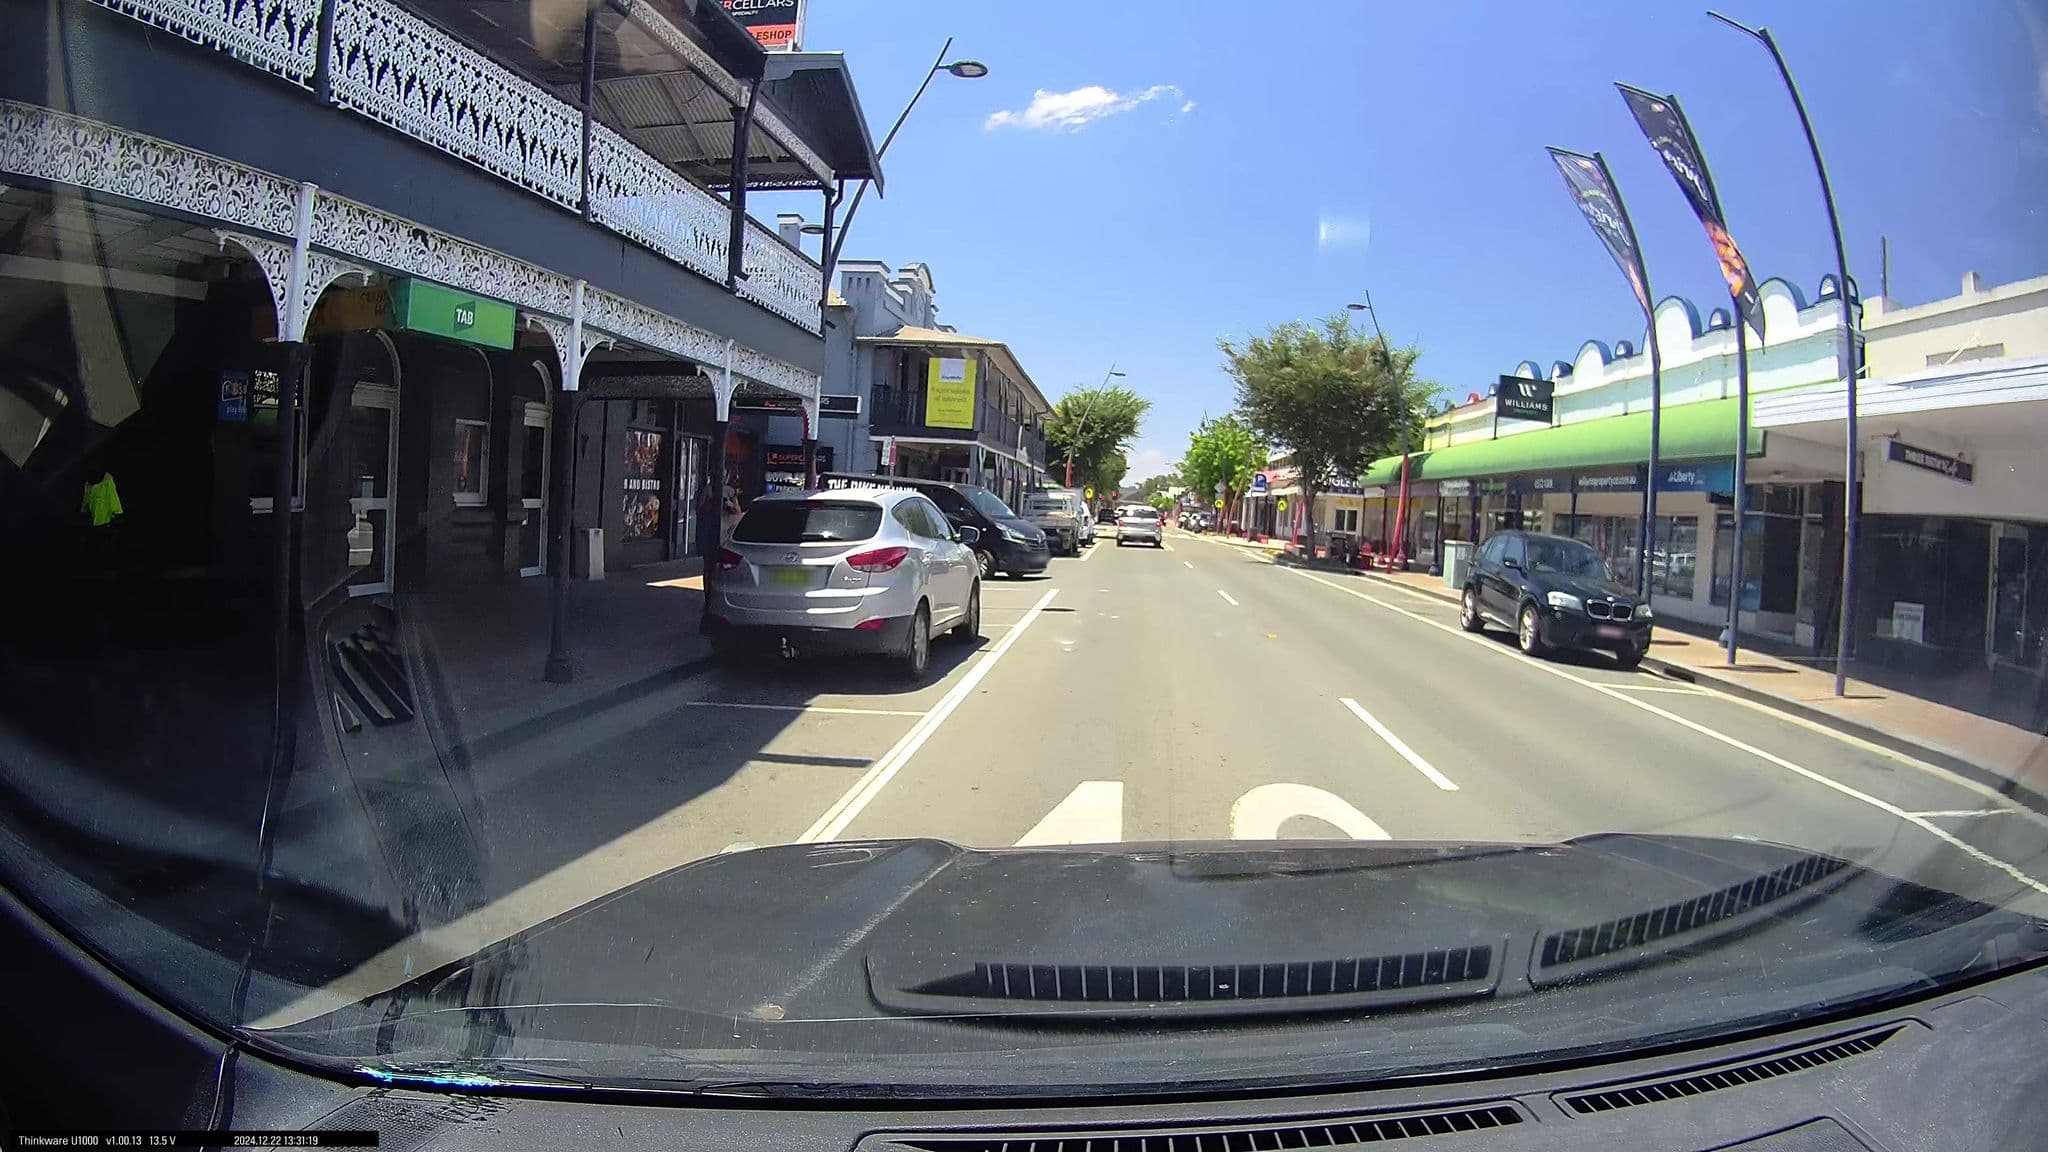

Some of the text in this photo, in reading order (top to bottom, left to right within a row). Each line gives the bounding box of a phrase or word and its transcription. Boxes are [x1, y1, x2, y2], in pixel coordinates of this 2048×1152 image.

[720, 0, 794, 10] RCELLARS
[755, 30, 792, 40] ESHOP
[456, 308, 473, 325] TAB
[1504, 399, 1548, 412] WILLIAMS
